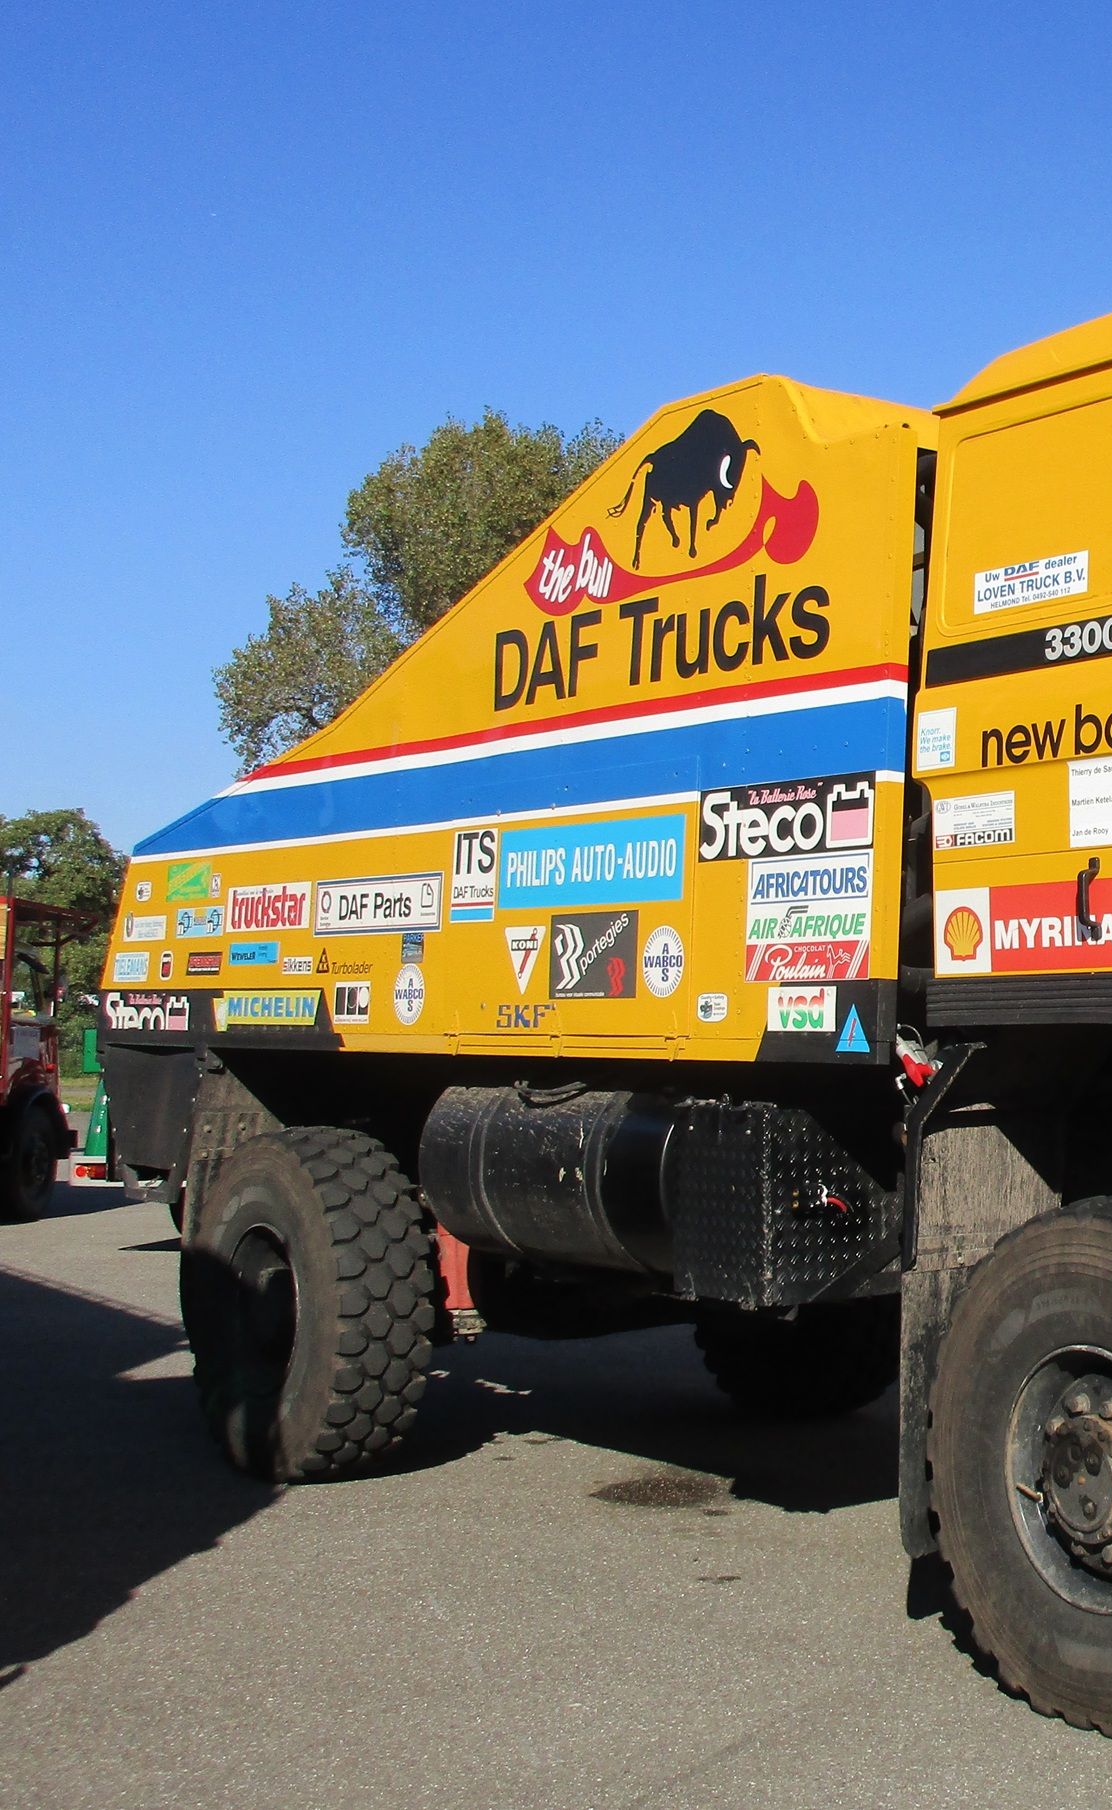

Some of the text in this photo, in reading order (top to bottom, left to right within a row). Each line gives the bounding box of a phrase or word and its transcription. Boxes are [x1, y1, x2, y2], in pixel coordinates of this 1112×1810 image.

[538, 533, 613, 603] the bull
[985, 556, 1077, 583] Uw DAF dealer
[977, 567, 1086, 602] LOVEN TRUCK B.V.
[990, 597, 1020, 610] HELMOND
[494, 574, 830, 712] DAF Trucks
[920, 744, 931, 753] the
[932, 734, 951, 743] make
[982, 718, 1066, 768] new
[1071, 768, 1092, 776] Thierry
[1093, 765, 1102, 774] de
[760, 785, 795, 804] Batterie
[1071, 796, 1095, 806] Martien
[700, 792, 824, 860] Steco
[957, 829, 1010, 846] FACOM
[1072, 828, 1083, 837] Jan
[1084, 827, 1092, 835] de
[1093, 826, 1109, 835] Rooy
[456, 830, 496, 876] ITS
[507, 838, 678, 888] PHILIPS AUTO-AUDIO
[453, 884, 494, 899] DAF Trucks
[753, 866, 867, 899] AFRICATOURS
[230, 885, 306, 930] truckstar
[339, 892, 412, 920] DAF Parts
[749, 912, 867, 940] AIR AFRIQUE
[512, 940, 538, 950] KONI
[579, 912, 630, 975] portegies
[794, 945, 826, 953] CHOCOLAT
[331, 961, 373, 975] Turbolader
[644, 954, 683, 968] WABCO
[765, 945, 826, 980] Poulain
[228, 996, 315, 1018] MICHELIN
[394, 988, 424, 1001] WABCO
[496, 1004, 550, 1029] SKF
[777, 987, 825, 1030] vsd
